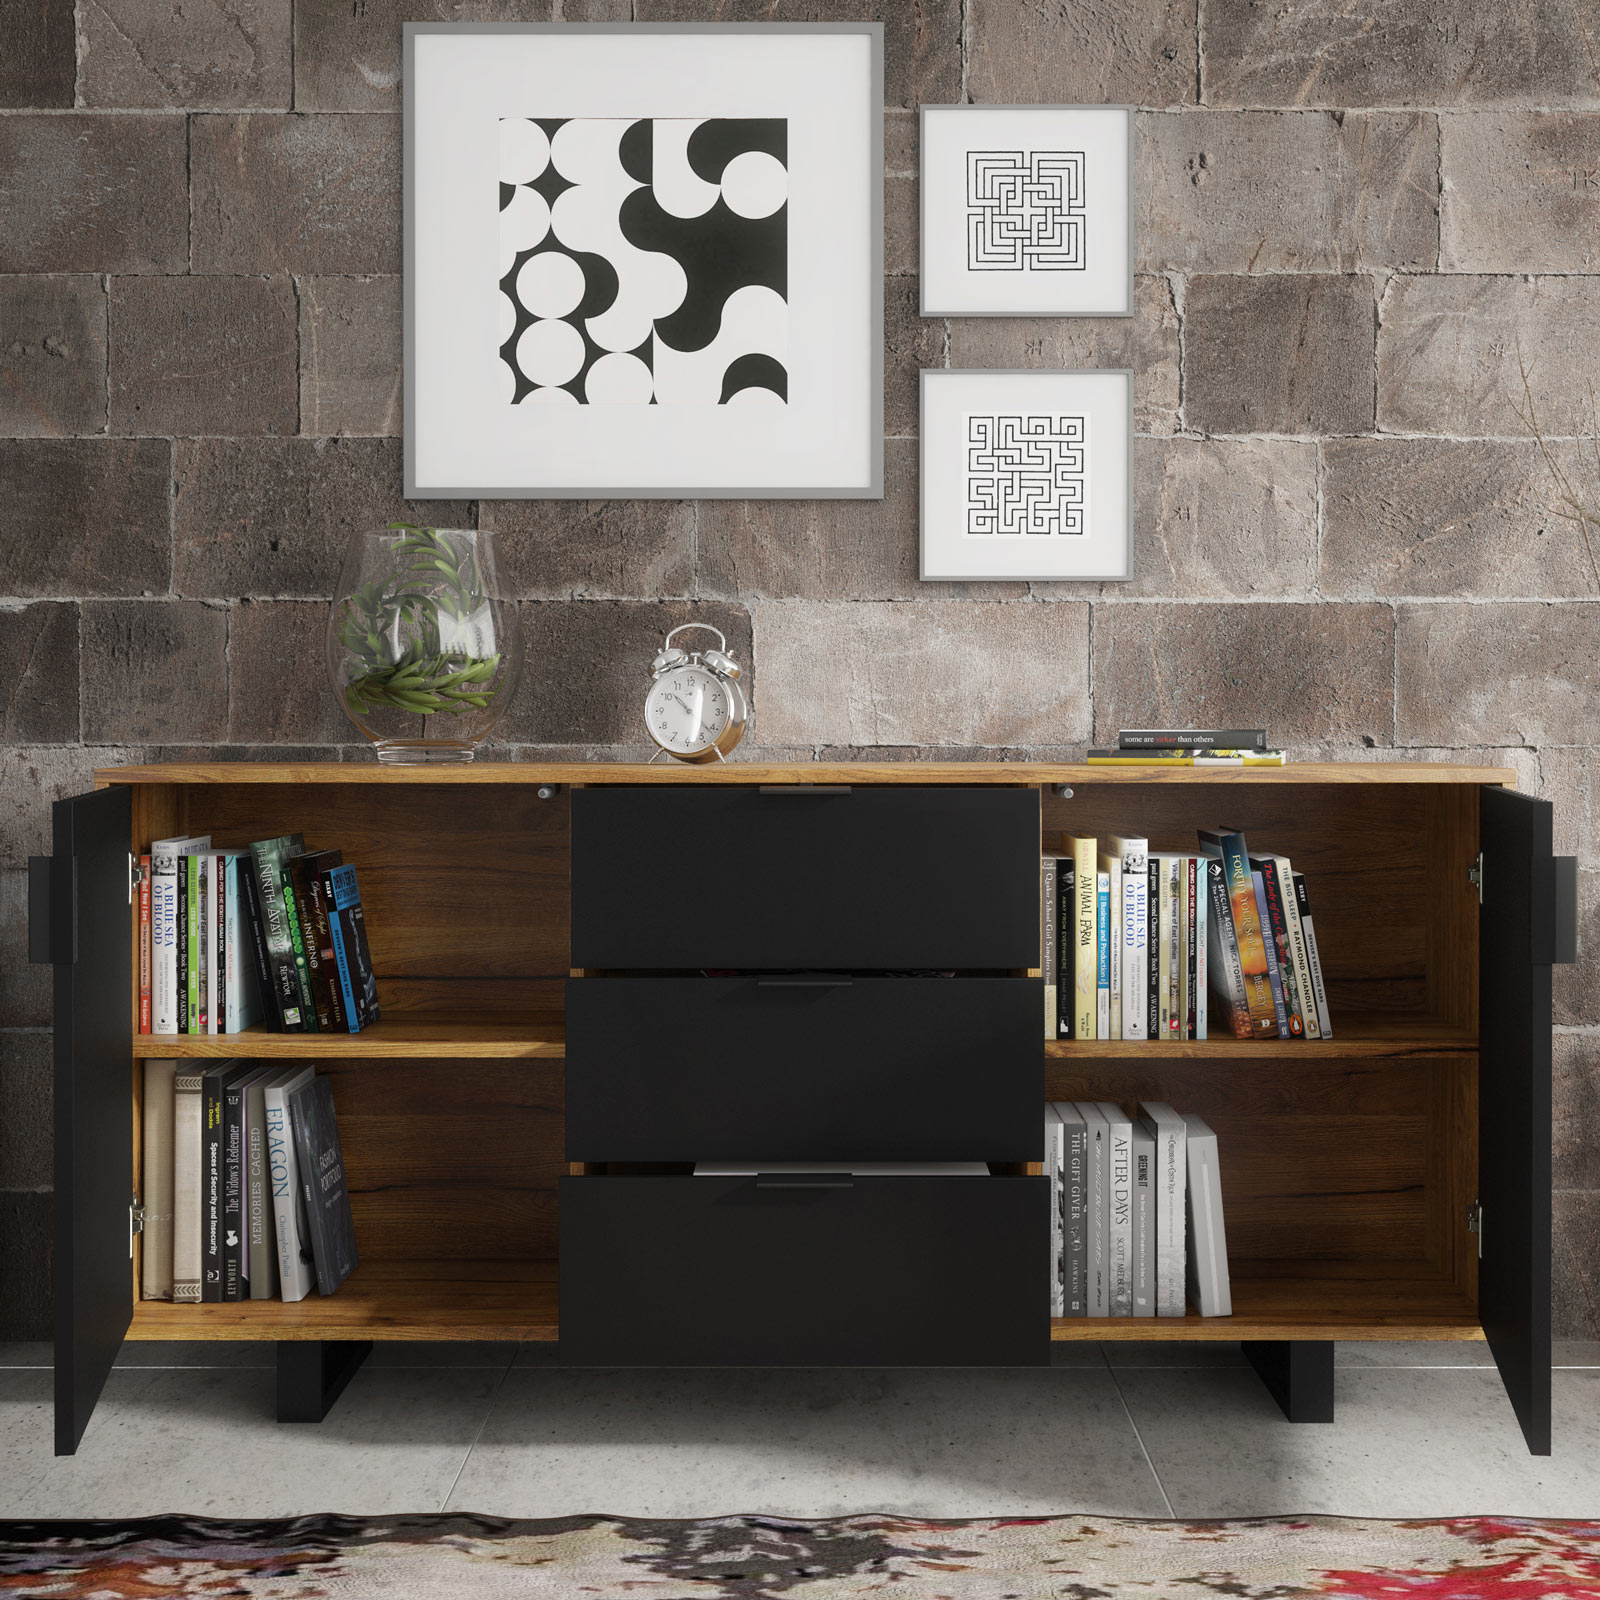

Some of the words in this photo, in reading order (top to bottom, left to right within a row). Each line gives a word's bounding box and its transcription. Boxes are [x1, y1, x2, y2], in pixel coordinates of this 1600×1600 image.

[659, 707, 664, 715] 9
[672, 732, 678, 740] 7
[256, 847, 268, 864] THE
[259, 864, 276, 904] NINTH
[1232, 855, 1244, 895] FORTIFY
[1264, 864, 1272, 879] The
[154, 885, 162, 901] OF
[1080, 874, 1092, 915] ANIMAL
[1126, 884, 1135, 901] OF
[1137, 882, 1145, 890] A
[1218, 884, 1229, 914] SPECIAL
[1266, 881, 1276, 900] Lady
[165, 894, 173, 924] BLUE
[1137, 894, 1145, 925] BLUE
[1240, 897, 1251, 926] YOUR
[1270, 902, 1280, 912] of
[1288, 900, 1296, 921] SLEEP
[154, 904, 162, 944] BLOOD
[165, 927, 174, 947] SEA
[267, 908, 284, 954] AVATAR
[1080, 919, 1093, 946] FARM
[1126, 903, 1135, 946] BLOOD
[1137, 927, 1145, 948] SEA
[1224, 917, 1234, 941] AGENT
[1260, 914, 1270, 937] HAGGIS
[1229, 944, 1238, 963] NICK
[1245, 928, 1255, 952] SOUL
[1265, 940, 1273, 948] TO
[1044, 941, 1053, 970] Samplers
[1267, 949, 1278, 975] ADDRESS
[279, 965, 291, 996] NEWTON
[1232, 965, 1242, 993] TORRES
[1293, 931, 1303, 971] RAYMOND
[1301, 973, 1313, 1014] CHANDLER
[329, 978, 338, 1005] KIMBERLY
[1254, 975, 1267, 1007] BERGEY
[209, 1142, 218, 1167] Spaces
[226, 1124, 239, 1163] Redeemer
[251, 1127, 261, 1176] CACHED
[266, 1107, 289, 1198] ERAGON
[1072, 1133, 1080, 1154] THE
[1072, 1158, 1080, 1183] GIFT
[1115, 1137, 1128, 1185] AFTER
[1138, 1155, 1148, 1180] GREENING
[209, 1176, 218, 1205] Security
[227, 1165, 239, 1196] Widow's
[226, 1199, 238, 1213] The
[252, 1182, 262, 1244] MEMORIES
[1072, 1186, 1080, 1219] GIVER
[1115, 1189, 1128, 1224] DAYS
[209, 1220, 217, 1255] Insecurity
[278, 1215, 289, 1254] Christopher
[1117, 1238, 1125, 1261] SCOTT
[228, 1259, 236, 1295] KEYWORTH
